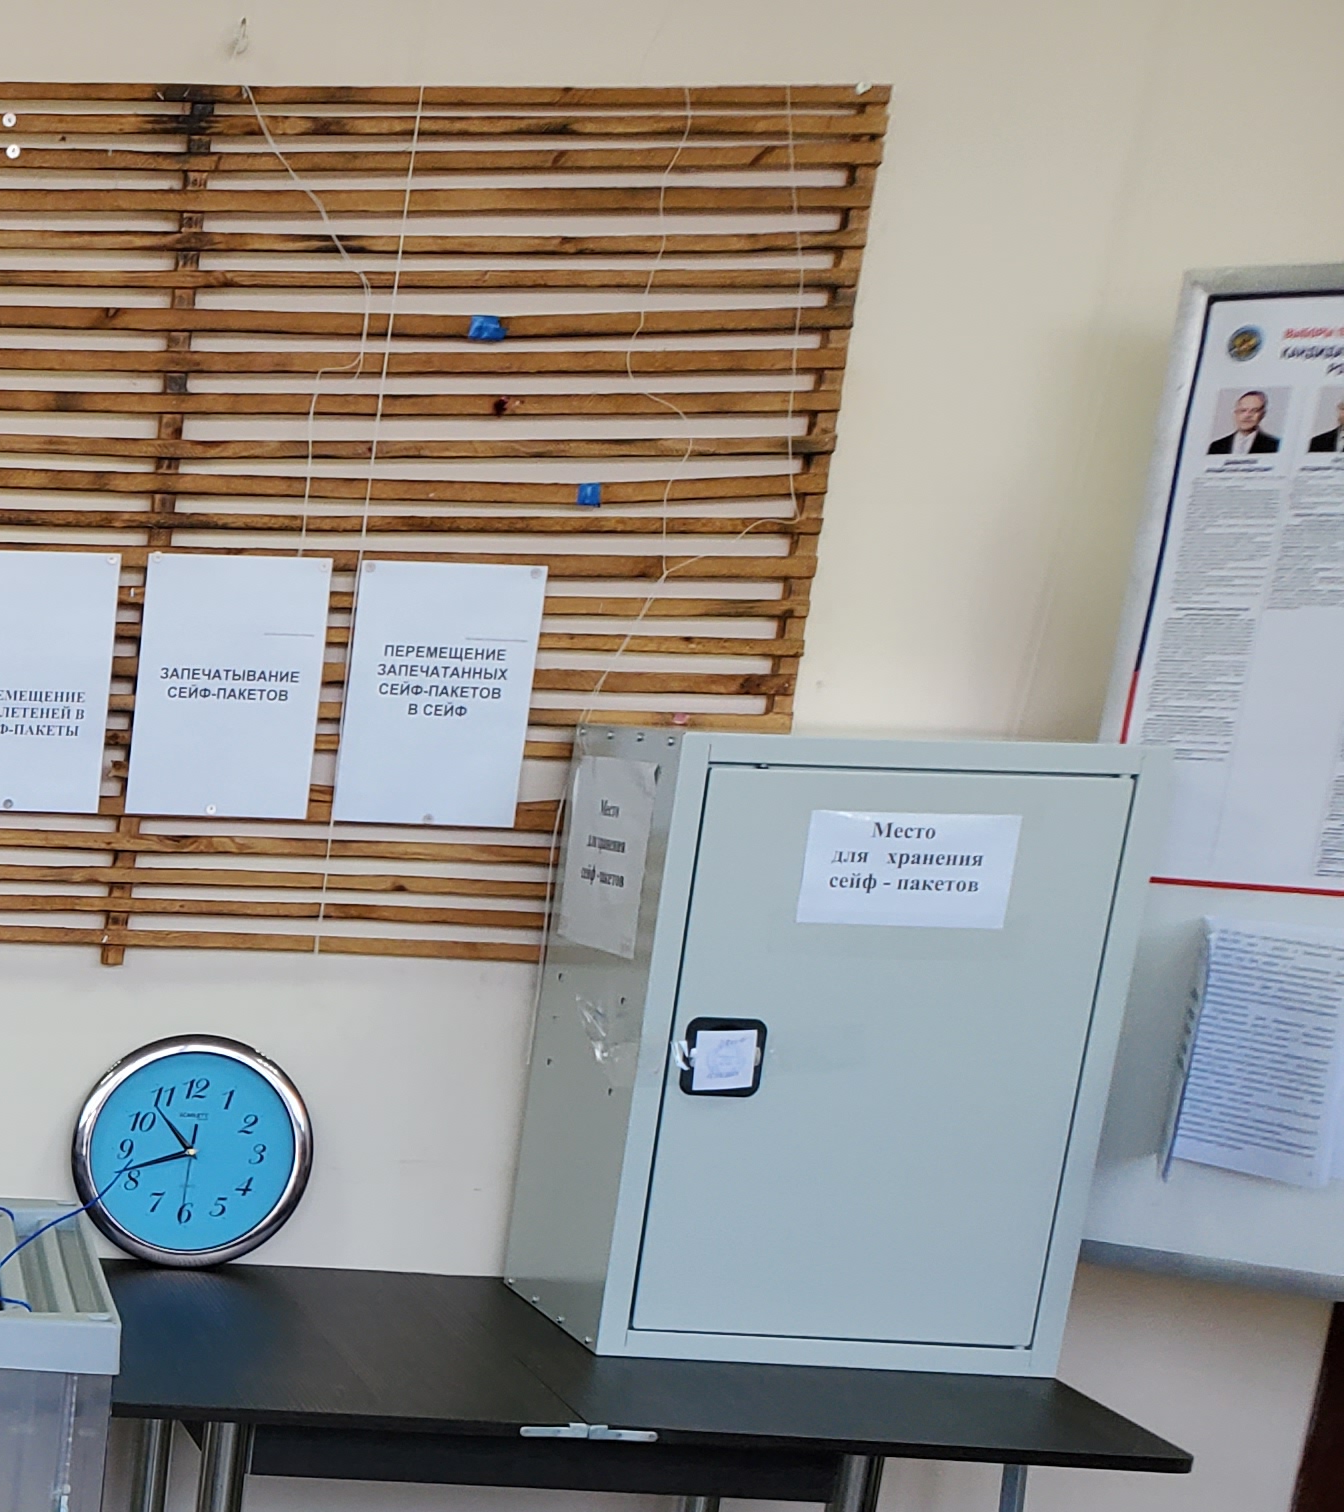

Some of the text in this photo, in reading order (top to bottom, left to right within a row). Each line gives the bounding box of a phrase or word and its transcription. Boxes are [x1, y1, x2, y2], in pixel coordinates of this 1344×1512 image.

[384, 645, 506, 661] ПЕРЕМЕЩЕНИЕ
[160, 668, 300, 682] ЗАПЕЧАТЫВАНИЕ
[378, 664, 508, 680] ЗАПЕЧАТАННЫХ
[168, 682, 290, 701] СЕЙФ-ПАКЕТОВ
[379, 679, 501, 699] СЕЙФ-ПАКЕТОВ
[76, 709, 84, 719] В
[408, 702, 467, 716] В СЕЙФ
[872, 822, 935, 839] Место
[832, 852, 983, 866] для хранения
[830, 873, 877, 893] сейф
[897, 879, 978, 891] пакетов
[152, 1087, 176, 1107] 11
[184, 1078, 210, 1099] 12
[222, 1089, 235, 1110] 1
[130, 1111, 156, 1132] 10
[237, 1114, 258, 1135] 2
[117, 1138, 134, 1160] 9
[248, 1144, 267, 1164] 3
[124, 1169, 141, 1191] 8
[235, 1177, 253, 1196] 4
[149, 1191, 166, 1213] 7
[209, 1197, 228, 1217] 5
[177, 1203, 192, 1224] 6
